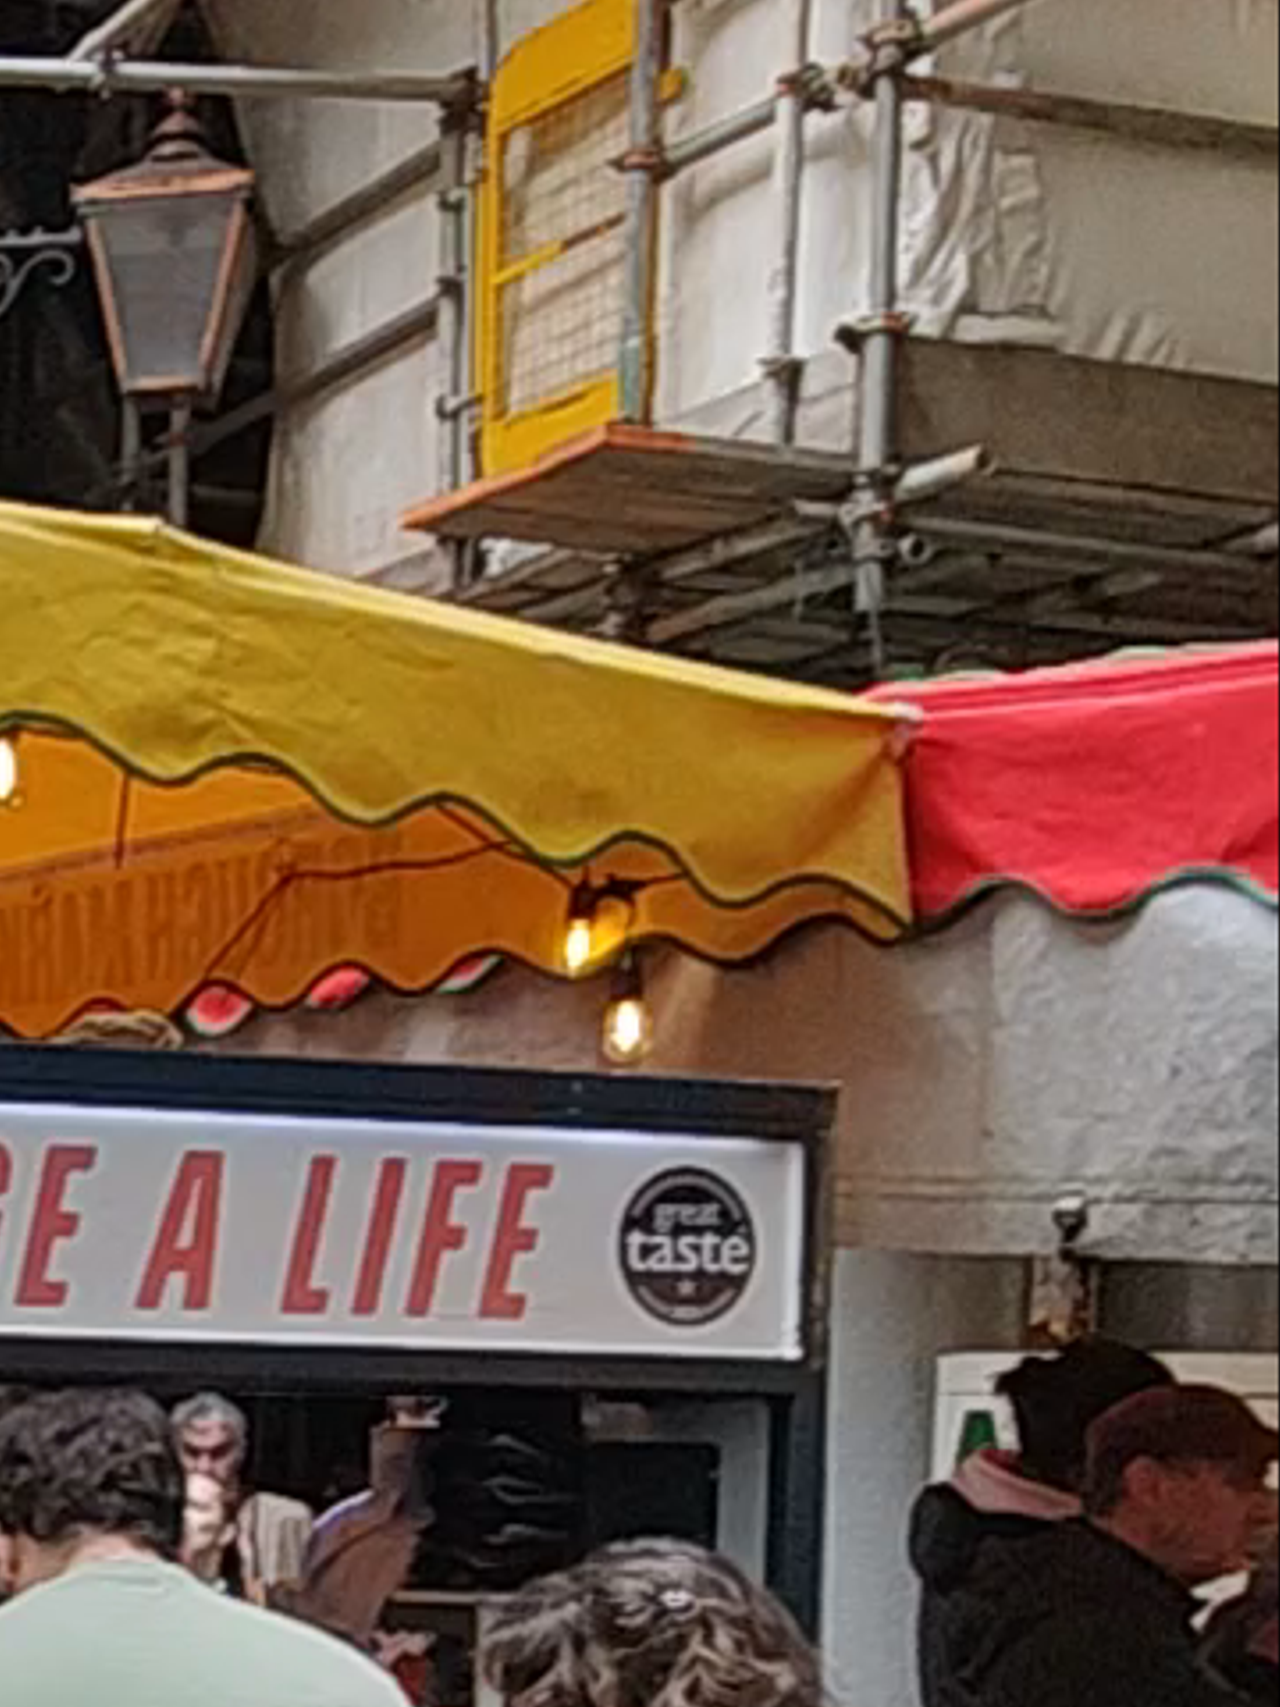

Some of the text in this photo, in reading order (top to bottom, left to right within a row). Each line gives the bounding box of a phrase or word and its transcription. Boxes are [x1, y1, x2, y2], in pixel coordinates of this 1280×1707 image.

[134, 1149, 225, 1310] A
[280, 1153, 554, 1320] LIFE
[652, 1201, 722, 1233] great
[626, 1229, 750, 1276] taste
